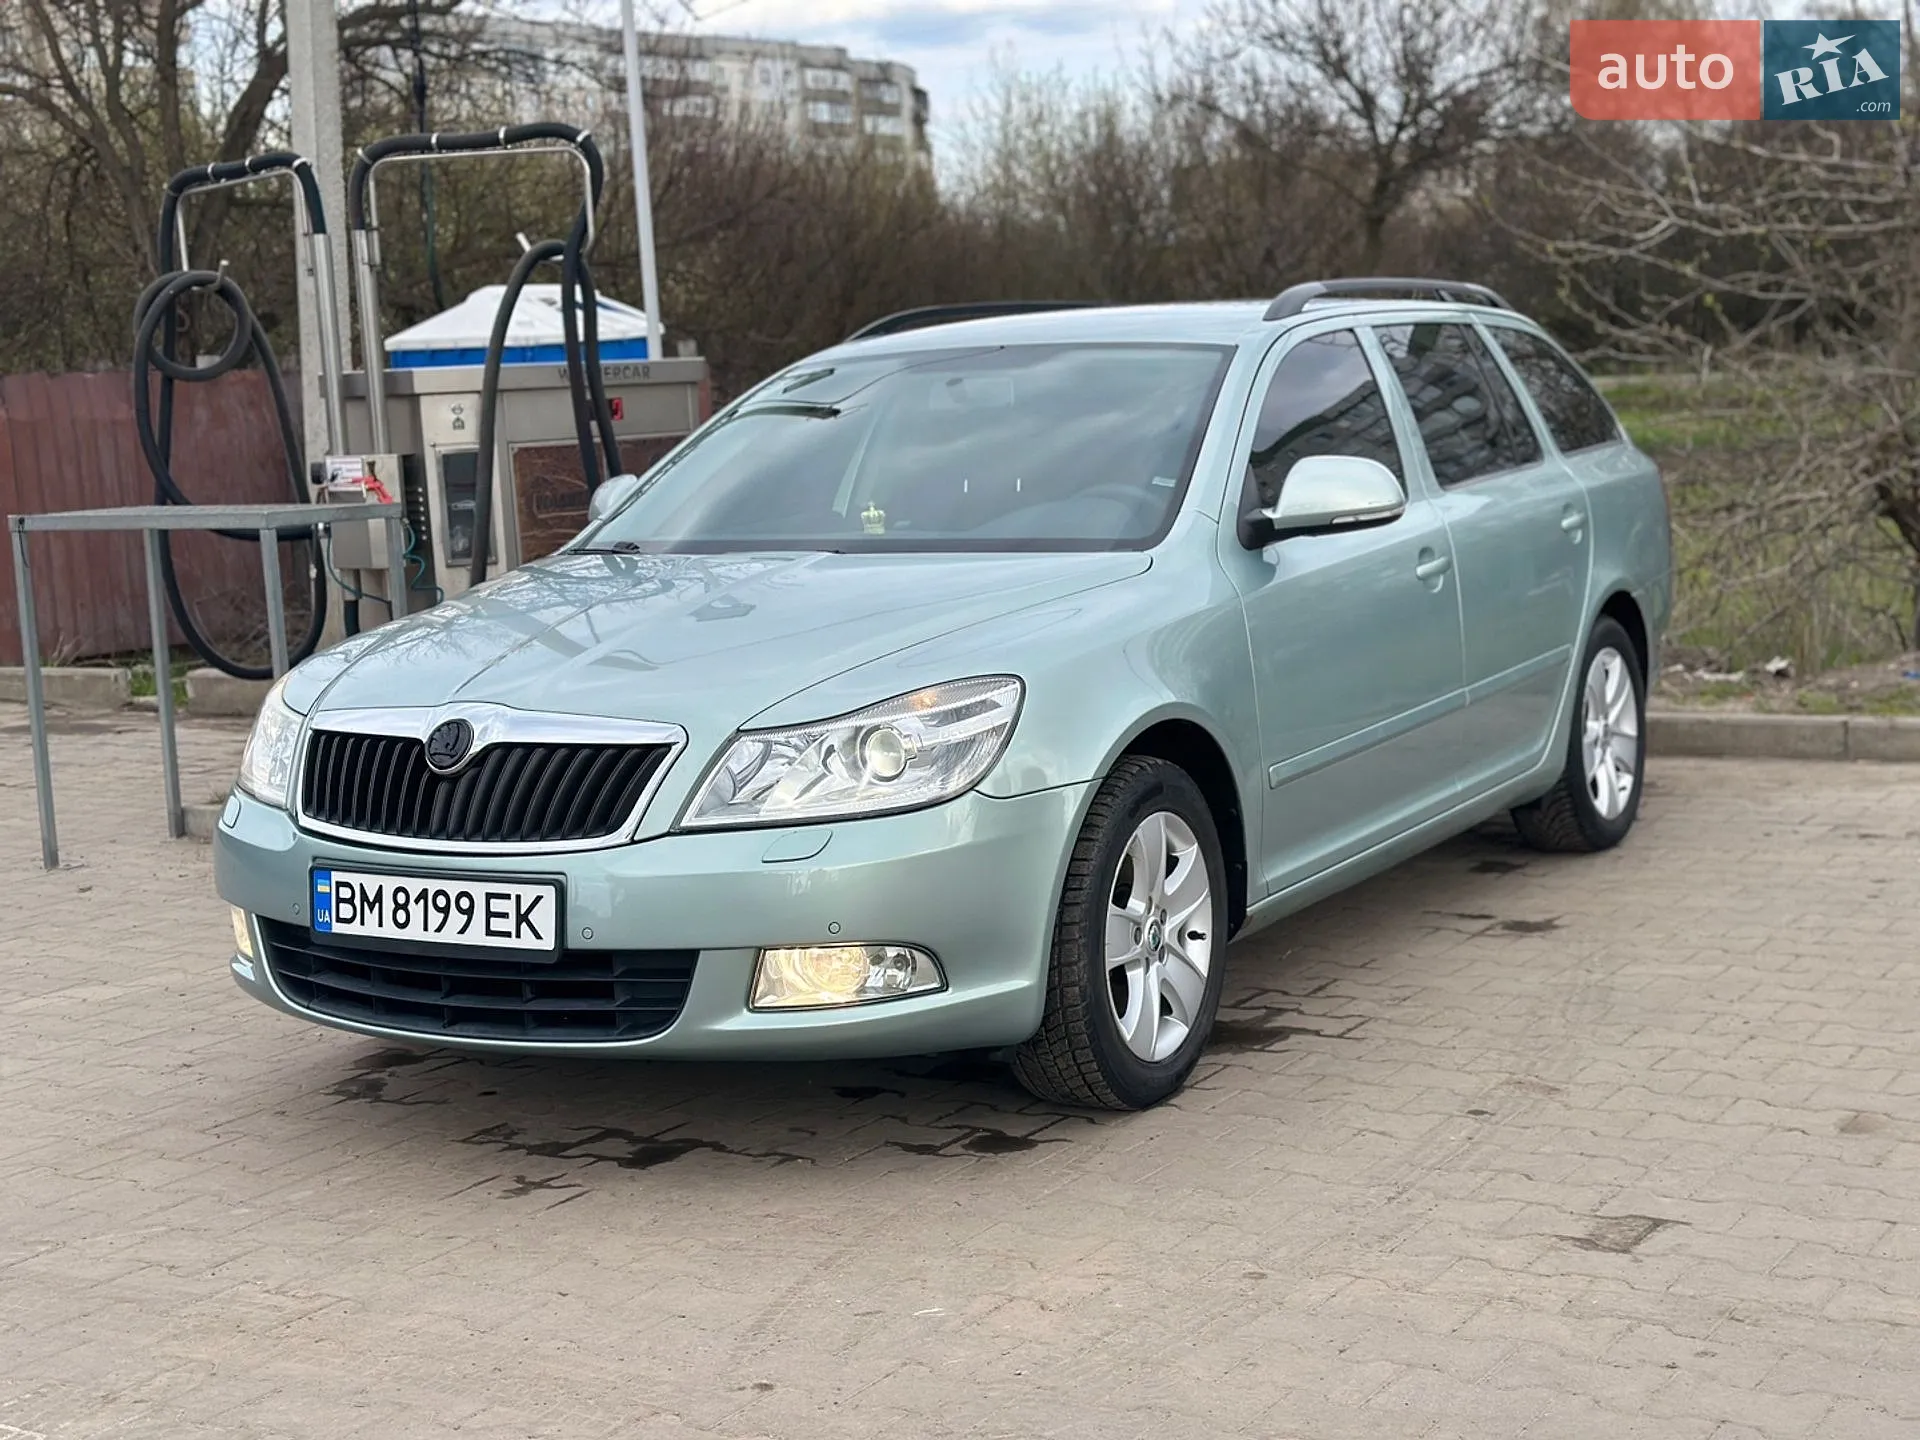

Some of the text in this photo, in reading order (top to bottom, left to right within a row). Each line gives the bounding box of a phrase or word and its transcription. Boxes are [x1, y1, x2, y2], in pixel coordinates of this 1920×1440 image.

[317, 910, 331, 924] UA
[335, 881, 544, 940] BM 8199 EK
